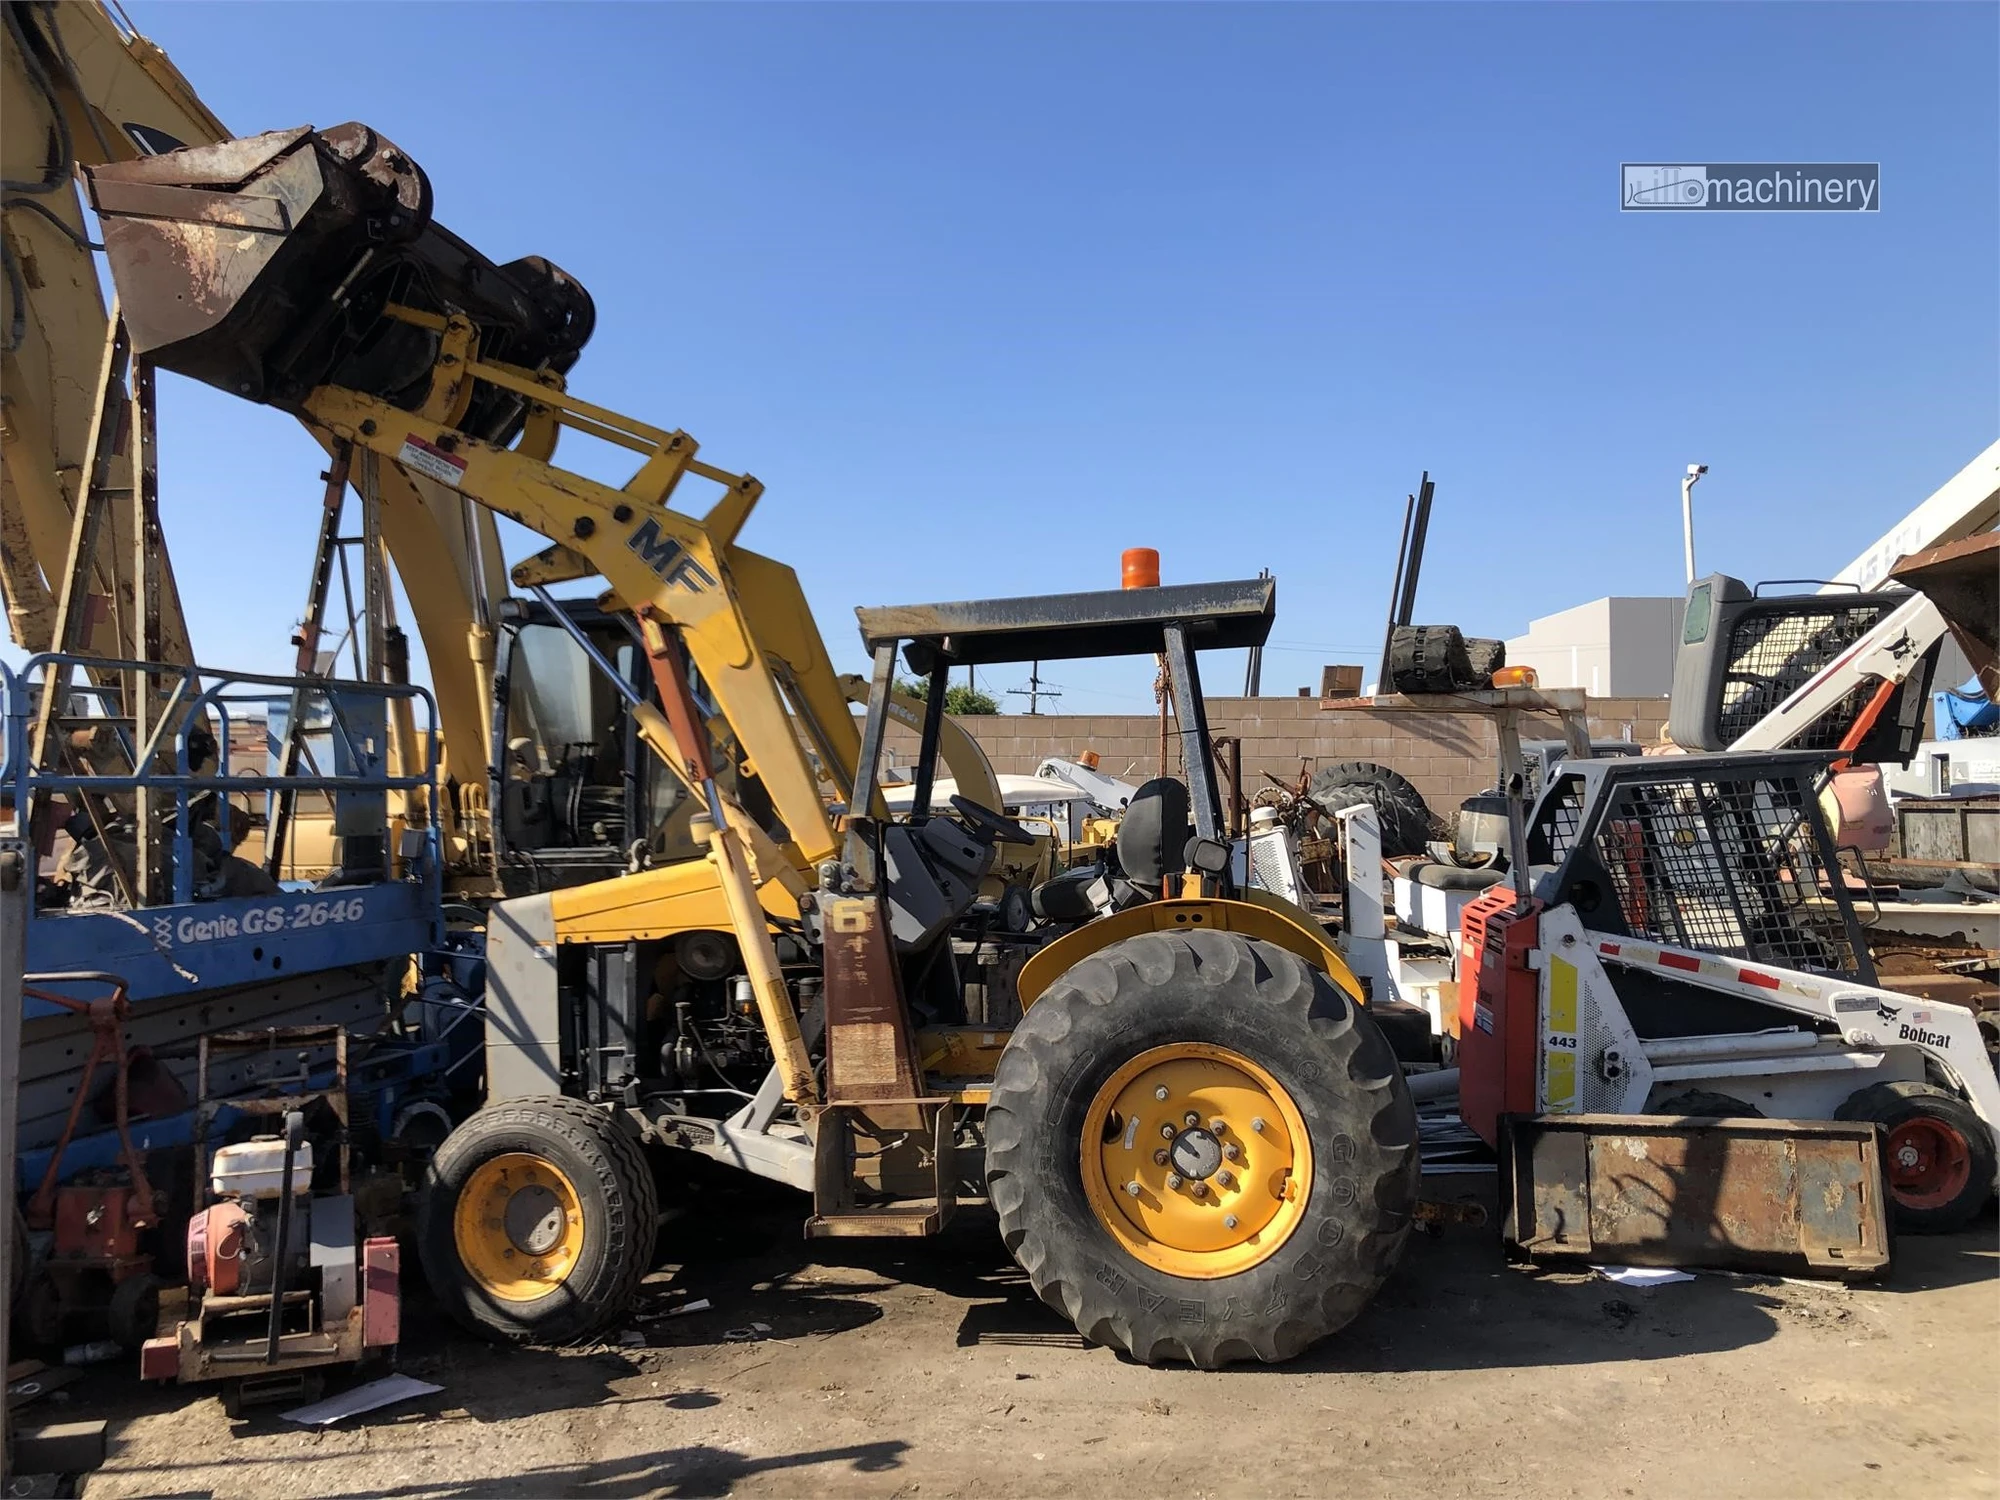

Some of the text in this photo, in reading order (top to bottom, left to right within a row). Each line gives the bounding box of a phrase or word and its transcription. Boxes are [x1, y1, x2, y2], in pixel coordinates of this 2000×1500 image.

[626, 515, 720, 594] MF
[177, 898, 364, 944] Genie GS-2646
[1549, 1036, 1577, 1048] 443
[1899, 1023, 1951, 1049] Bobcat
